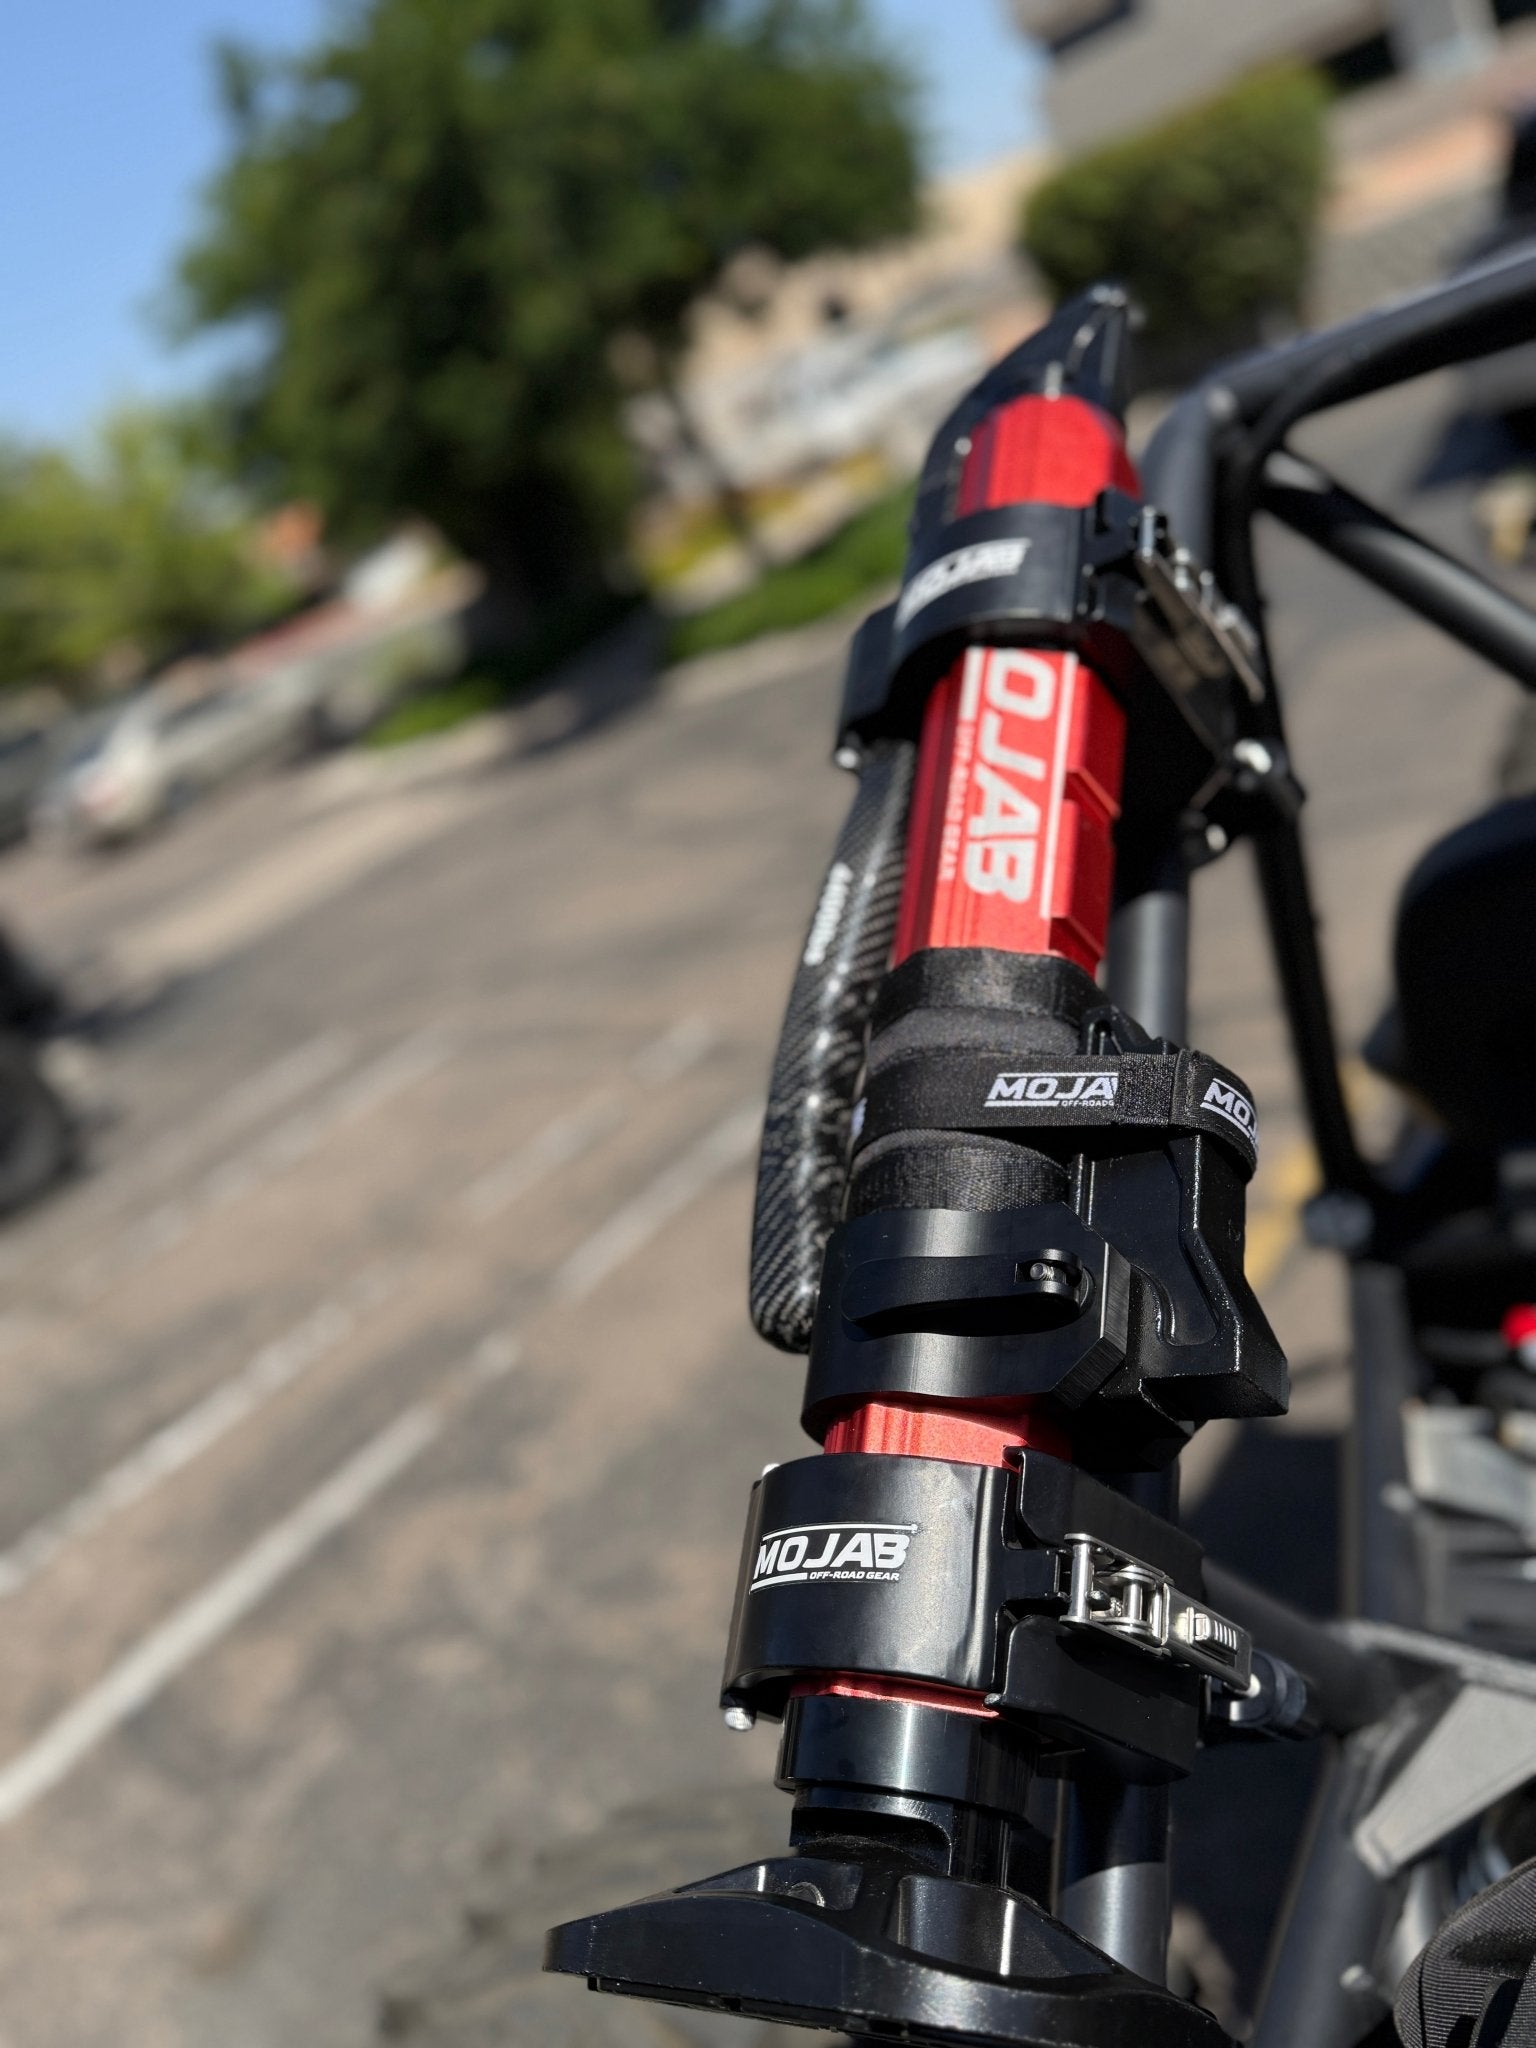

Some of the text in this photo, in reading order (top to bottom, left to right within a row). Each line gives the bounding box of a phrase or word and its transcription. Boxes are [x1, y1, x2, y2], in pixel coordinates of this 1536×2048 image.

[987, 1077, 1118, 1100] MOJA
[753, 1533, 910, 1580] MOJAB
[809, 1571, 900, 1581] OFF-ROAD GEAR
